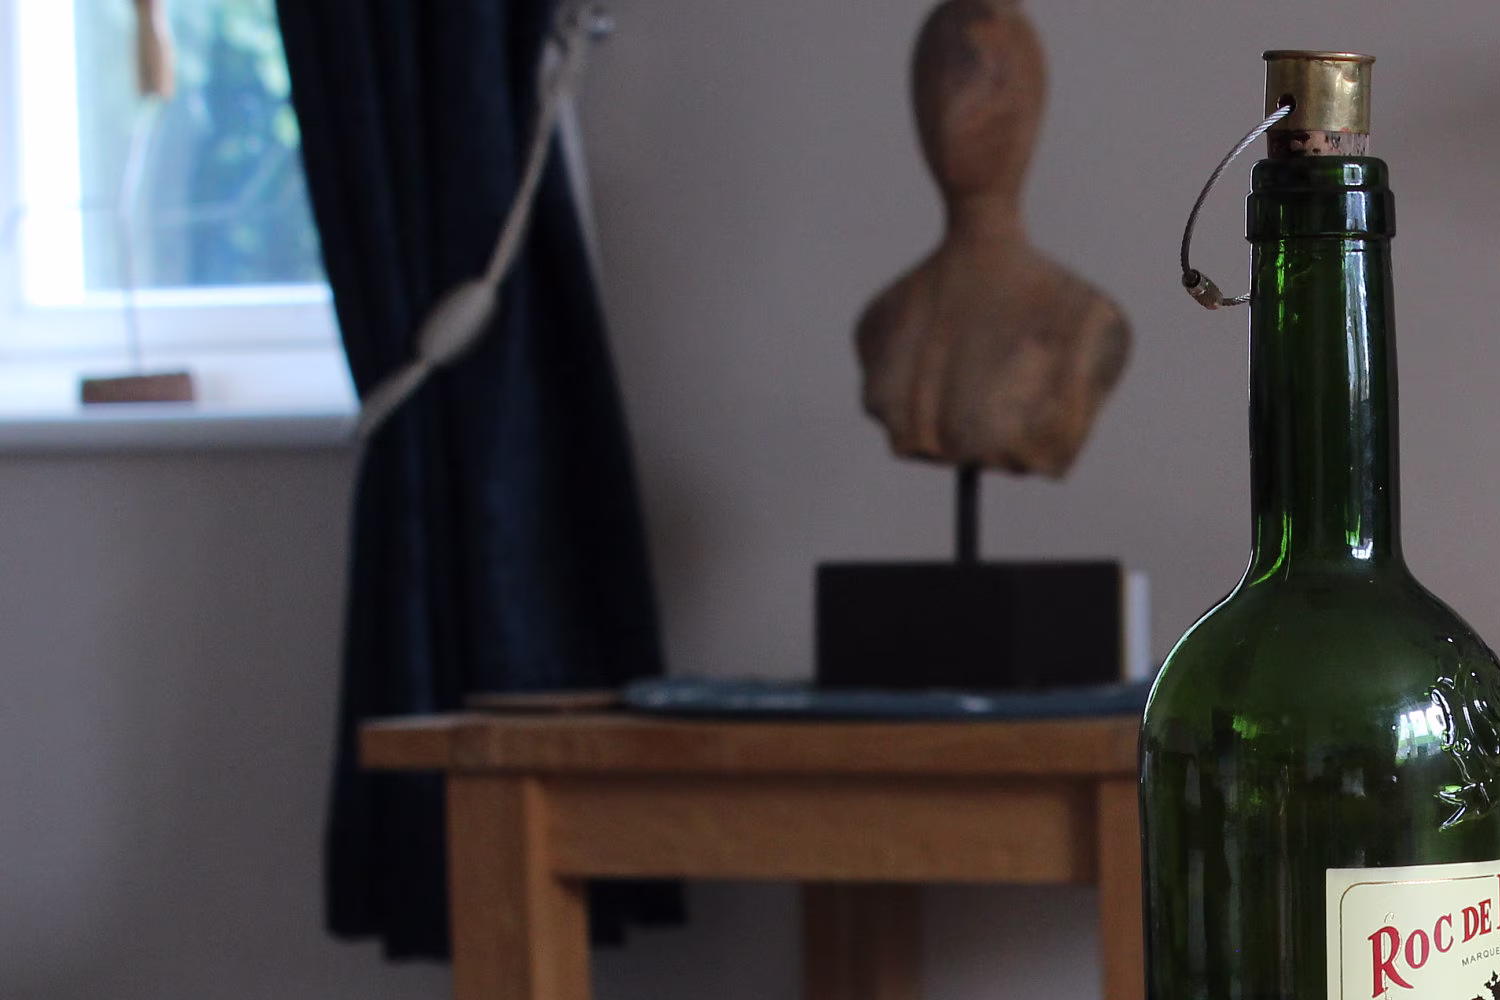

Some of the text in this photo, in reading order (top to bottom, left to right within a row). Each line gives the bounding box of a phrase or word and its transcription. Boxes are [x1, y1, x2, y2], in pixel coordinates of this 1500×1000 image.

[1367, 913, 1454, 999] ROC
[1461, 899, 1492, 943] DE
[1461, 946, 1500, 967] MARQUE
